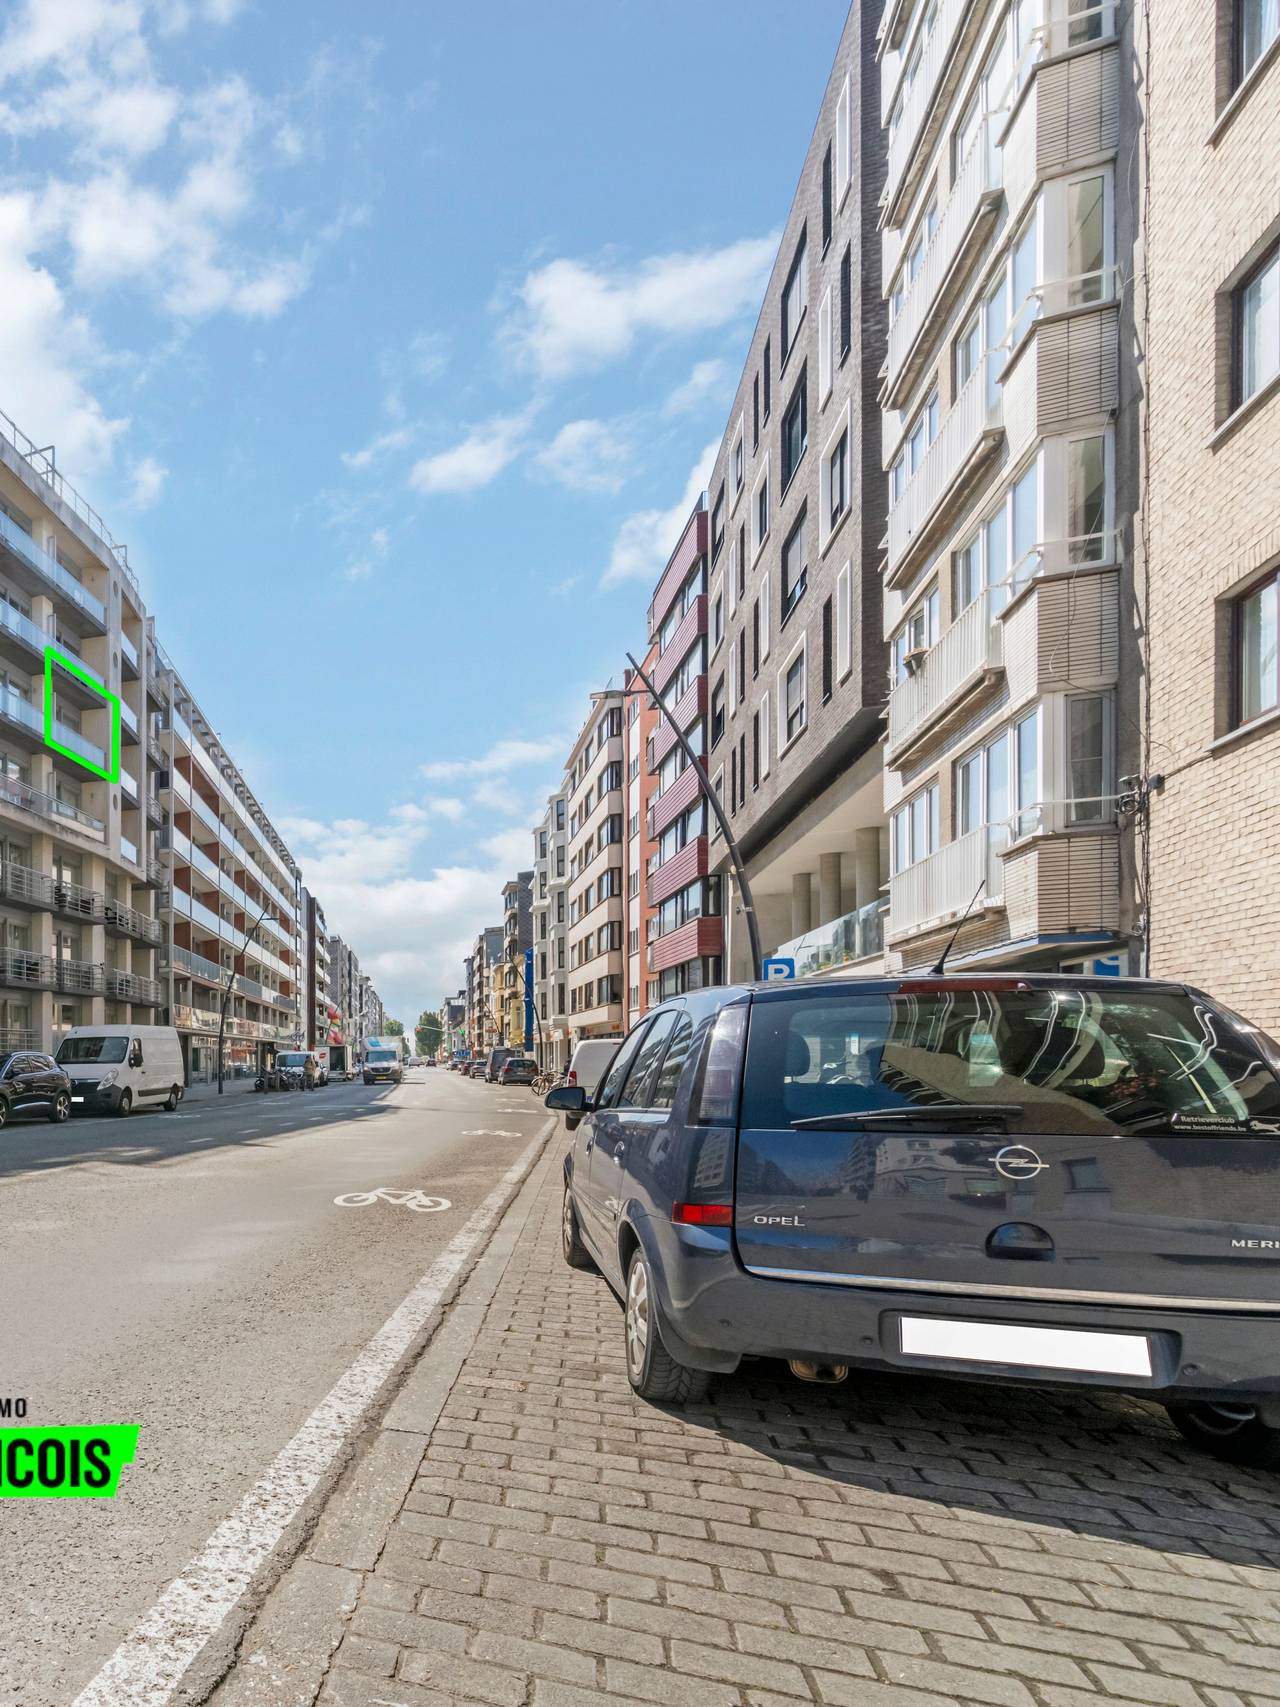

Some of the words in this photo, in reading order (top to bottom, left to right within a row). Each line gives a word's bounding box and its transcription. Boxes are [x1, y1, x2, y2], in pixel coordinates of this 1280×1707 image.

[767, 963, 790, 981] P
[1180, 1115, 1235, 1124] Retrieverclub
[753, 1215, 806, 1227] OPEL
[1231, 1239, 1280, 1249] MERI
